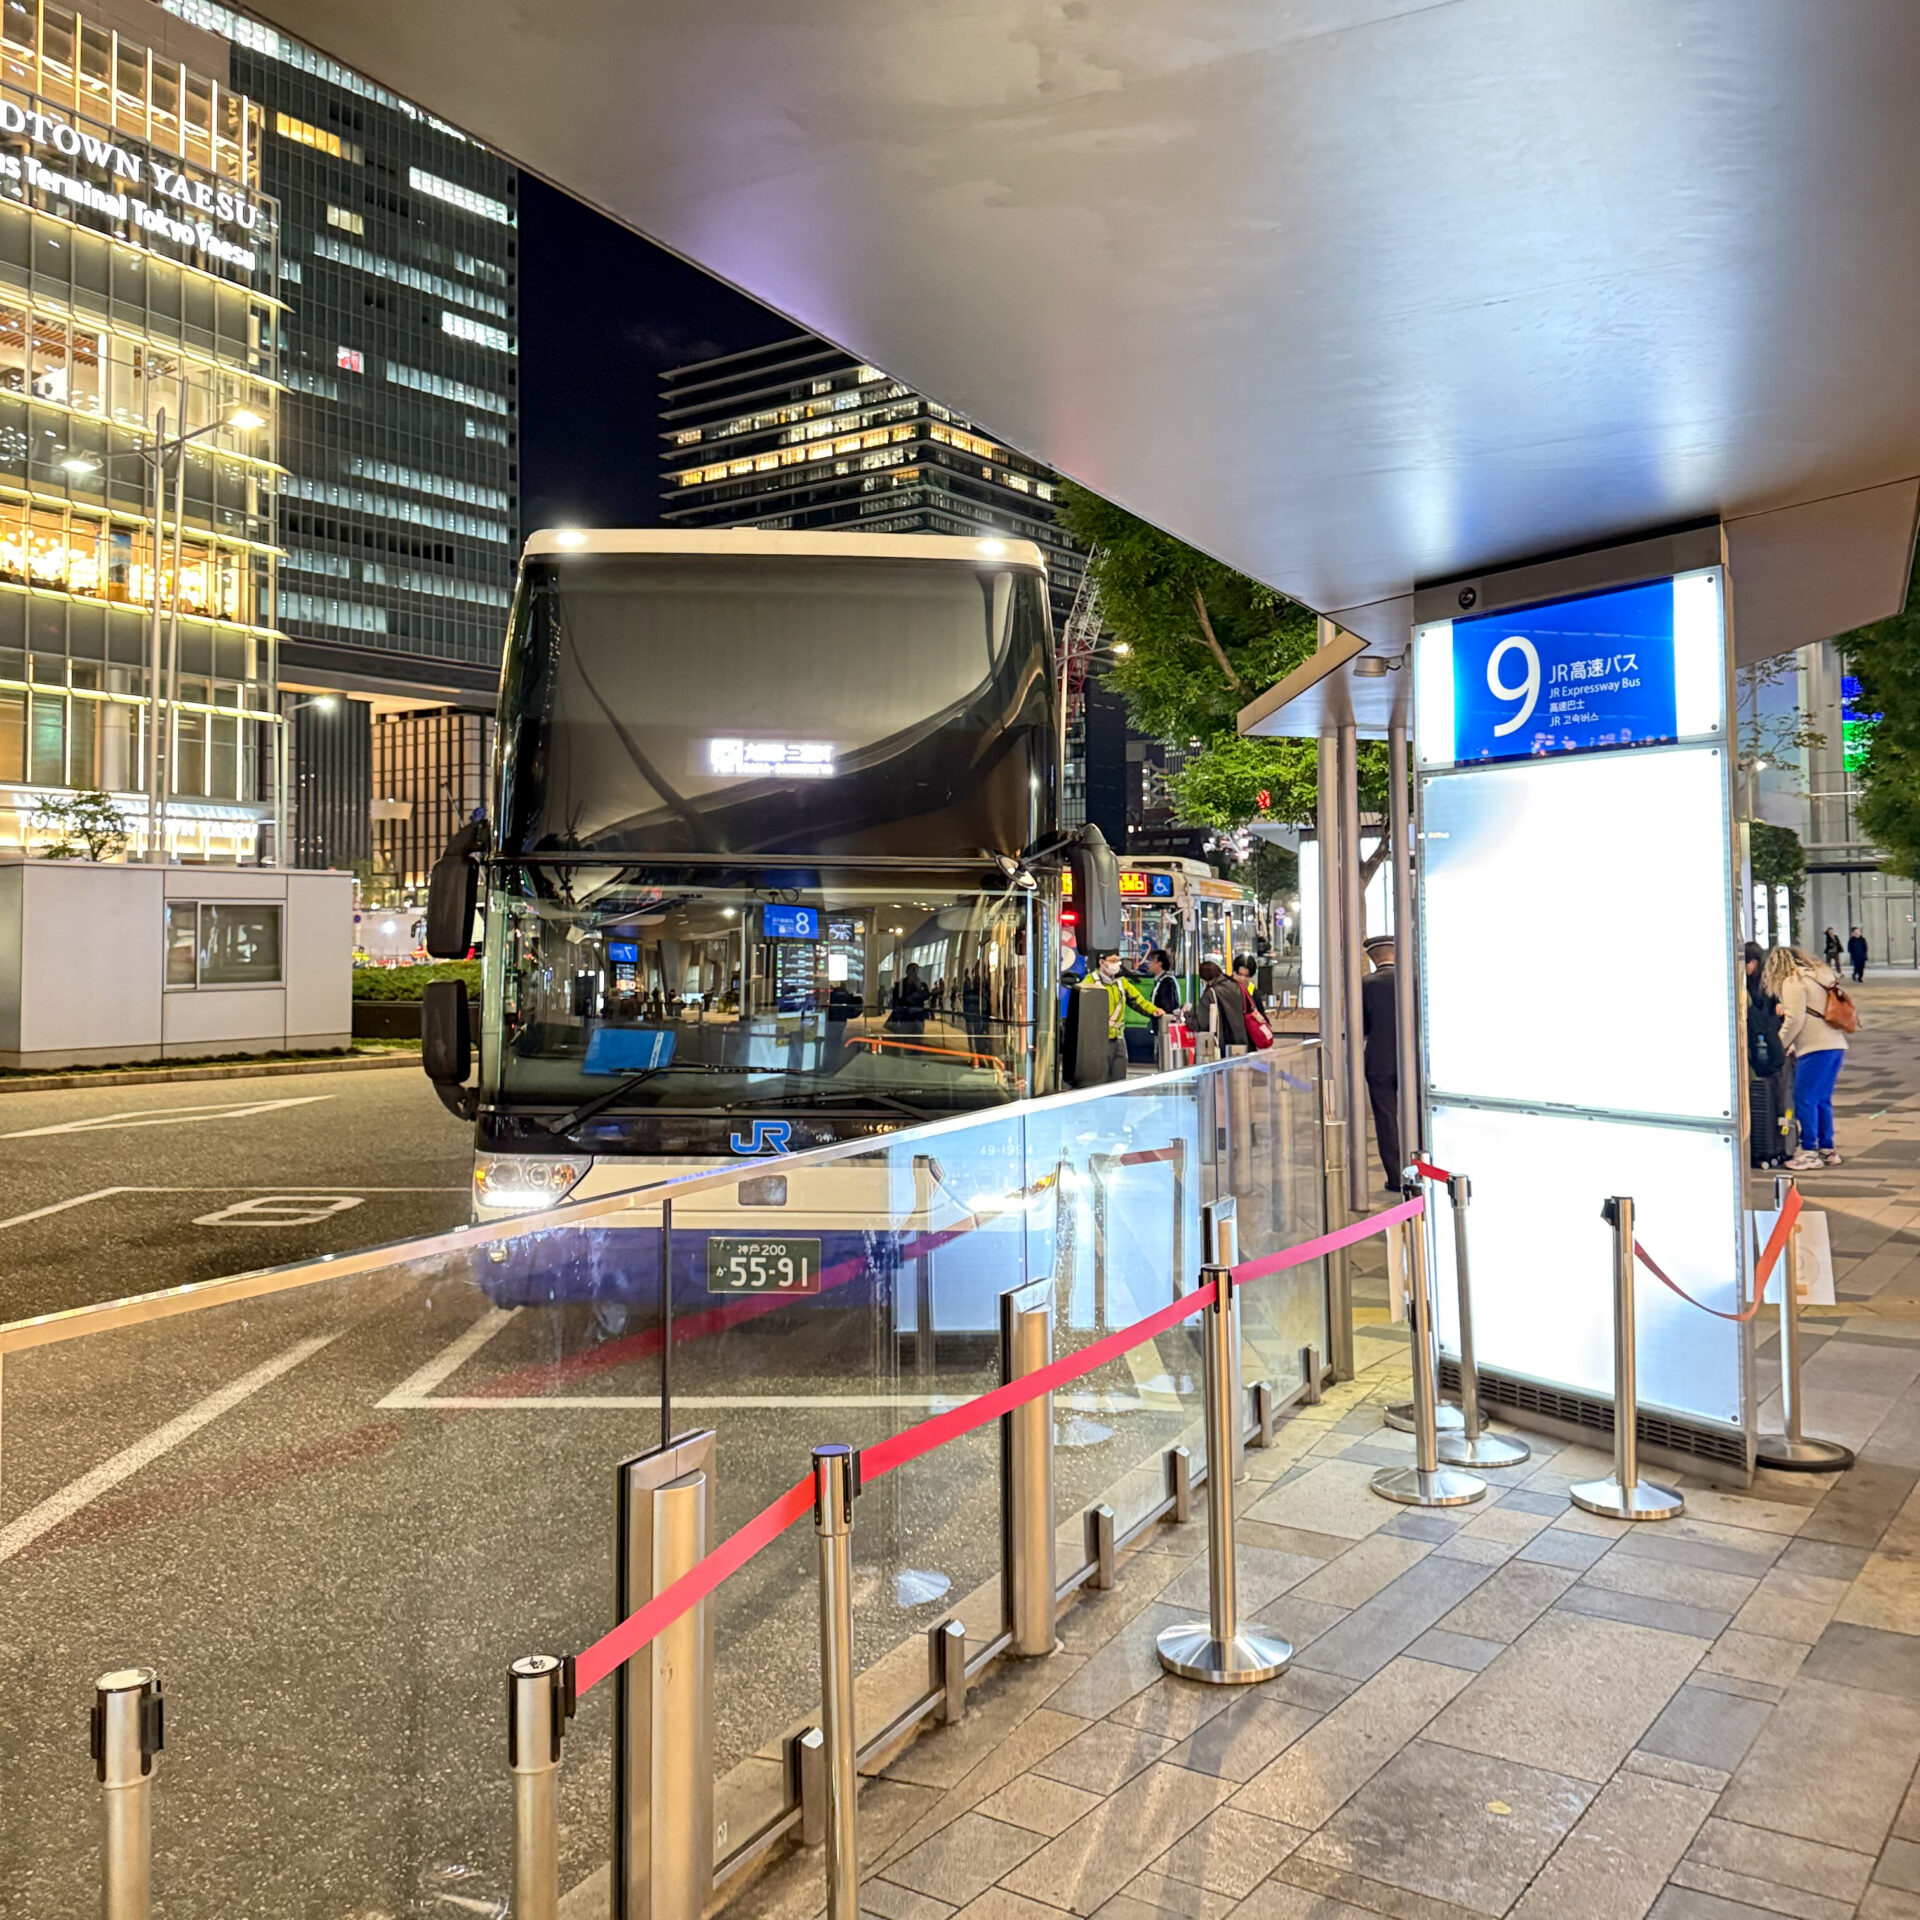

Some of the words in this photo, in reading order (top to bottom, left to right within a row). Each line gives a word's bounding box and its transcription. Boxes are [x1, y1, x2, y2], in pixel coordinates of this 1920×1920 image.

[149, 162, 257, 229] YAESU
[24, 156, 127, 221] Terminal
[131, 199, 195, 245] Tokyo
[195, 222, 256, 271] Yaesu
[1548, 653, 1639, 685] JR高速バス
[1487, 635, 1541, 737] 9
[1548, 687, 1560, 699] JR
[1561, 683, 1620, 698] Expressway
[1621, 677, 1641, 689] Bus
[1549, 716, 1562, 728] JR
[730, 1120, 792, 1156] JR
[761, 1244, 787, 1256] 200
[730, 1256, 808, 1288] 55-91
